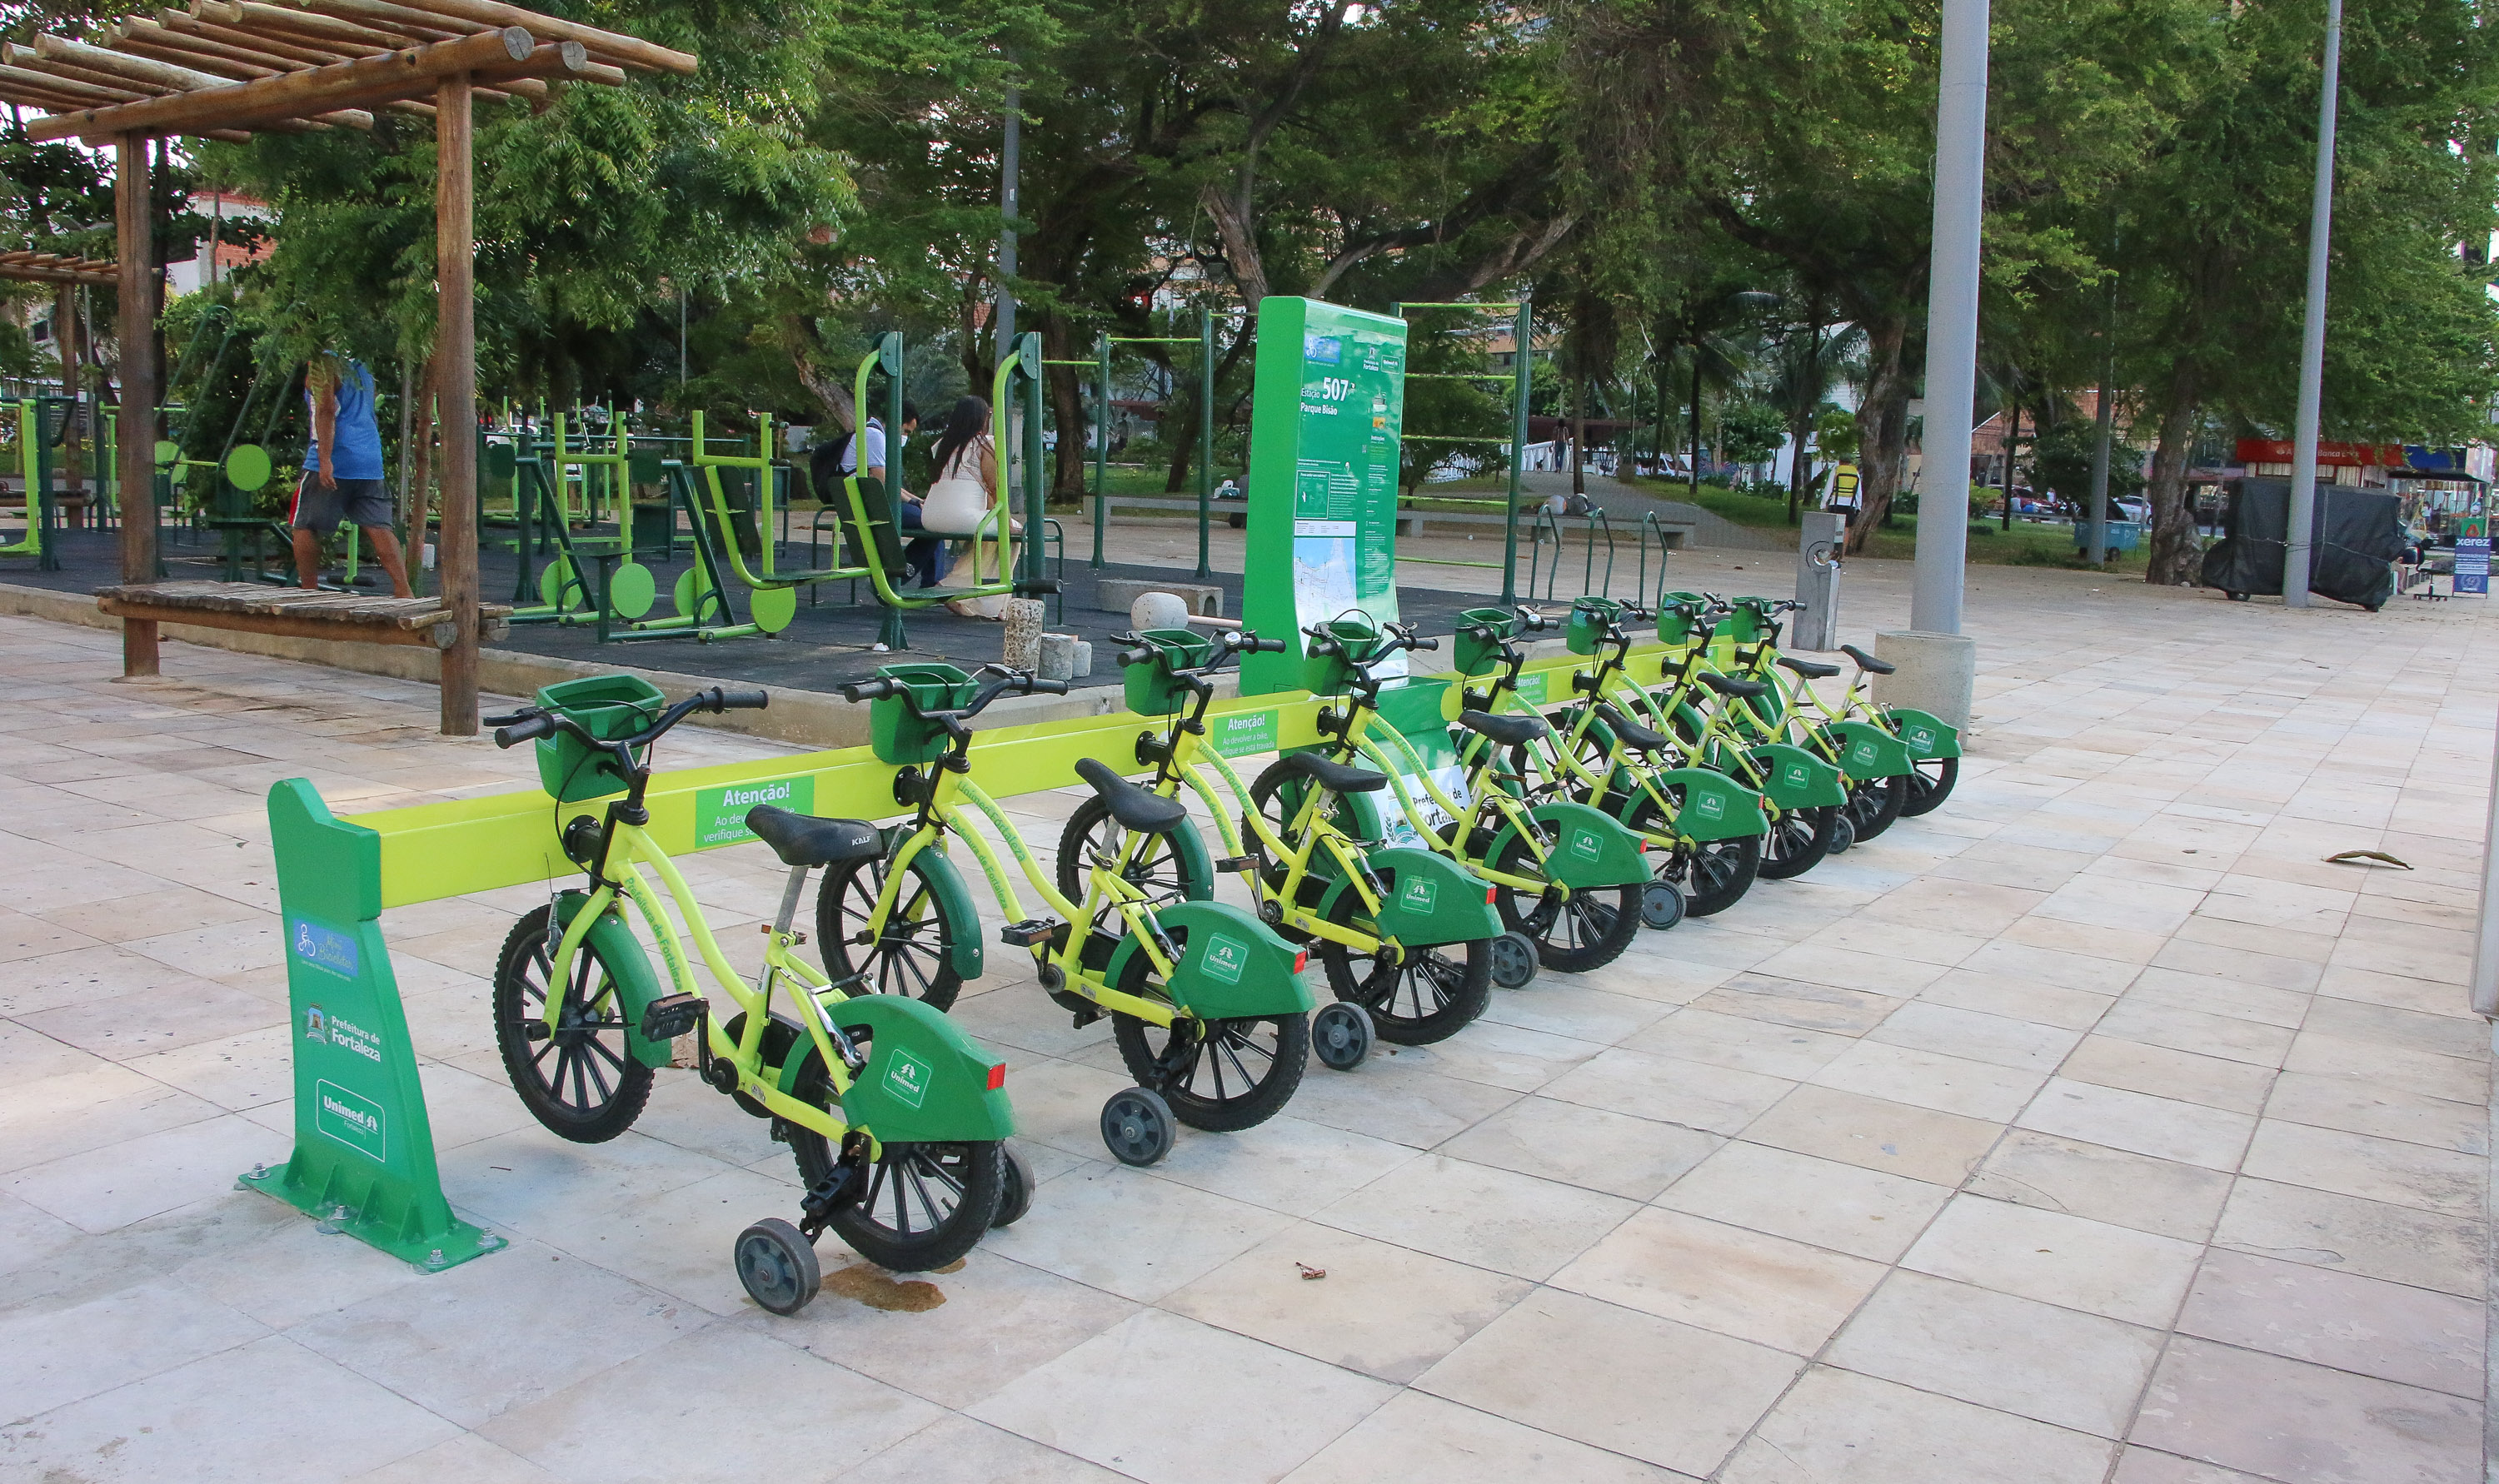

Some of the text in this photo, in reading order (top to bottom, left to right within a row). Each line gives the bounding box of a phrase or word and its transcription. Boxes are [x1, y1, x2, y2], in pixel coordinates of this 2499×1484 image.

[1301, 376, 1349, 401] Estação 507
[1300, 402, 1338, 416] Parque Bisão
[2456, 538, 2491, 546] xerez
[1227, 714, 1265, 731] Atenção!
[1230, 734, 1253, 744] devolver
[1256, 740, 1274, 749] travada
[1374, 718, 1427, 779] Unimed Fortaleza
[1199, 743, 1253, 815] Unimed Fortaleza
[723, 782, 791, 806] Atenção!
[1453, 788, 1462, 799] de
[715, 816, 727, 827] Ao
[958, 781, 1025, 862] Unimed Fortaleza
[704, 829, 743, 844] verifique
[950, 817, 1007, 909] Prefeitura de Fortaleza
[1406, 894, 1430, 903] Unimed
[660, 939, 681, 990] Fortaleza
[1210, 954, 1238, 970] Unimed
[332, 1015, 381, 1045] Prefeitura de
[332, 1028, 381, 1063] Fortaleza
[890, 1070, 920, 1093] Unimed
[323, 1095, 364, 1124] Unimed
